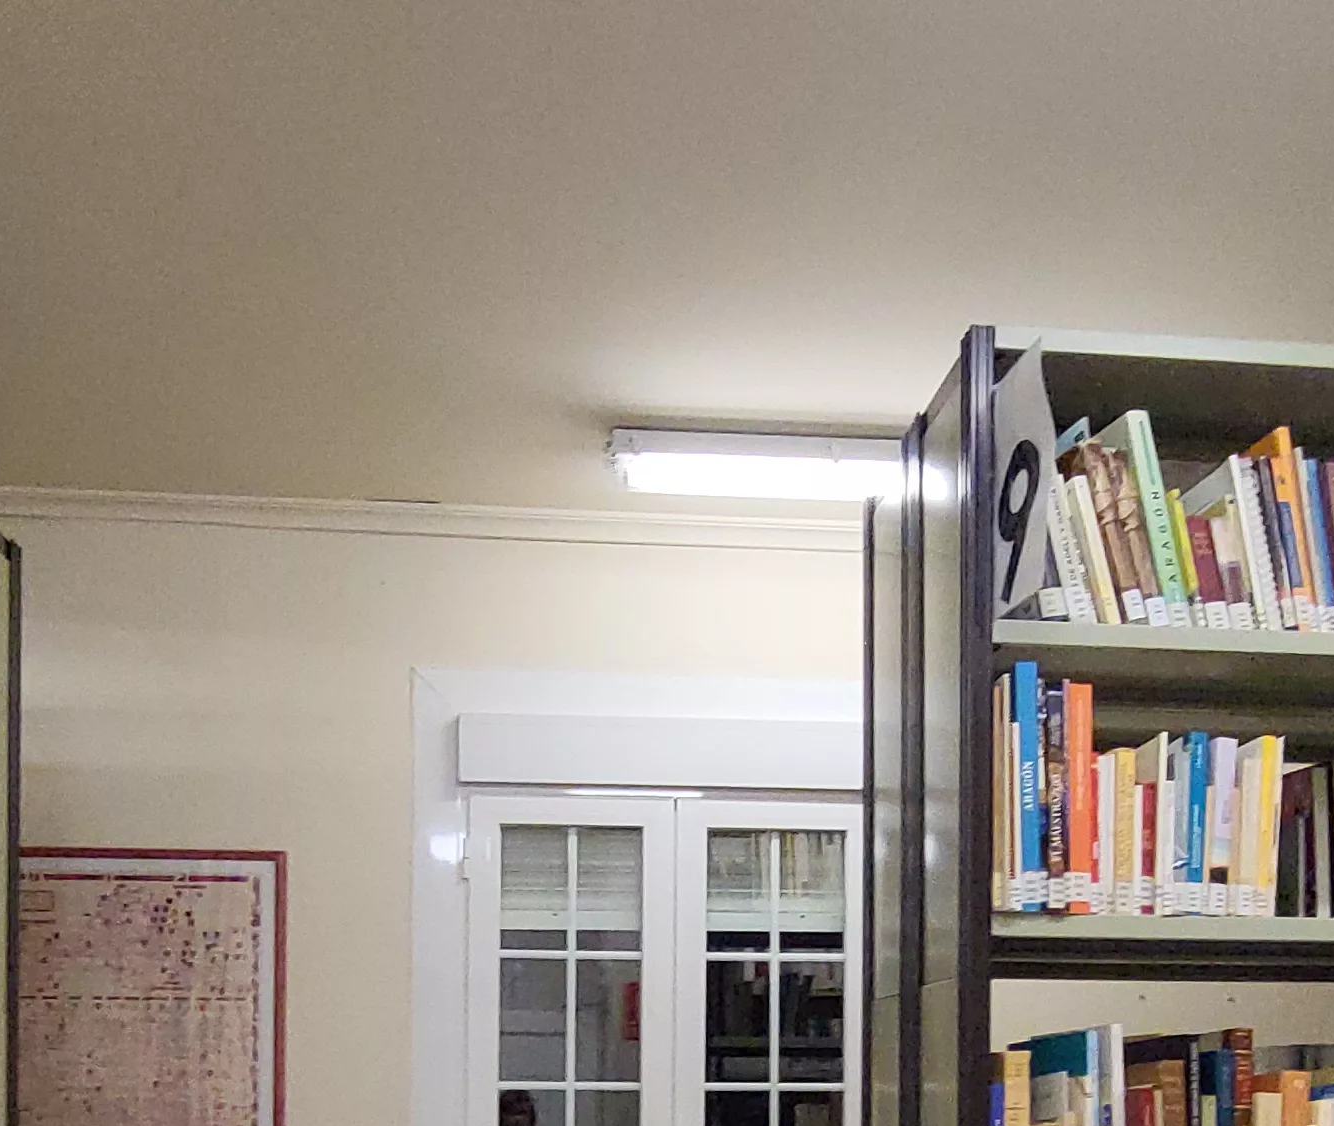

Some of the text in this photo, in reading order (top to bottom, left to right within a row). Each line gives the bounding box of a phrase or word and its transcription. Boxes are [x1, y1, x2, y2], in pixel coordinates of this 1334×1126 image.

[999, 440, 1040, 602] 9
[1150, 491, 1179, 583] ARAGÓN
[1020, 760, 1035, 812] ARAGÓN
